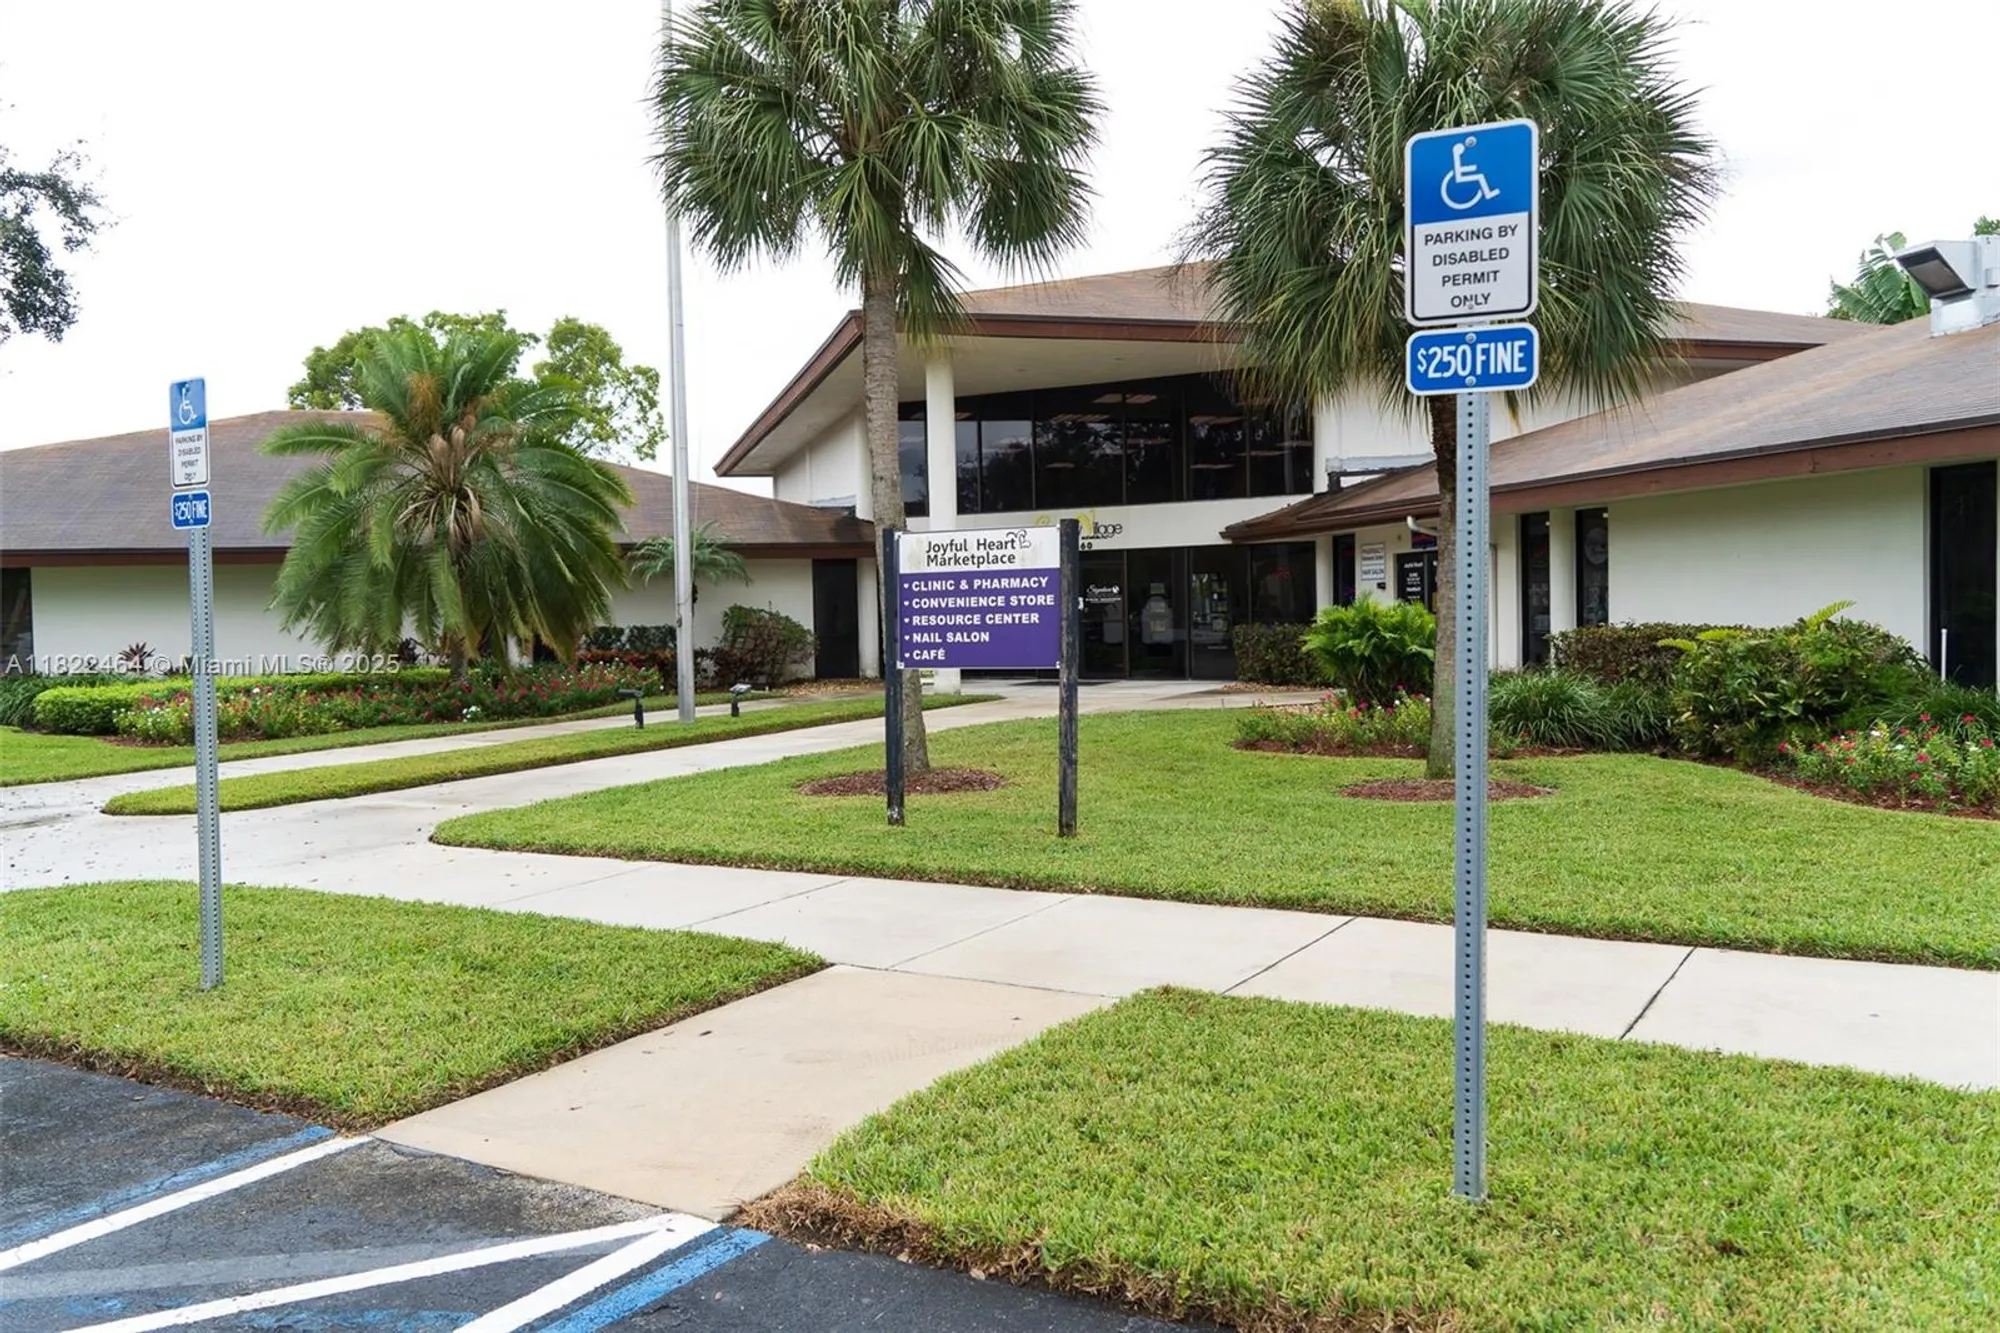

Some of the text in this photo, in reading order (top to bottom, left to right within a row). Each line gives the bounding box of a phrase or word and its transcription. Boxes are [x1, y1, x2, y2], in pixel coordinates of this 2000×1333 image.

[1424, 224, 1519, 246] PARKING BY
[1432, 247, 1510, 267] DISABLED
[1441, 270, 1500, 287] PERMIT
[1450, 292, 1491, 309] ONLY
[1417, 339, 1528, 379] $250 FINE
[175, 499, 208, 520] $250 FINE
[926, 537, 1016, 555] Joyful Heart
[926, 551, 1016, 569] Marketplace
[912, 576, 1049, 592] CLINIC & PHARMACY
[912, 594, 1055, 609] CONVENIENCE STORE
[912, 612, 1040, 626] RESOURCE CENTER
[913, 631, 990, 643] NAIL SALON
[913, 647, 946, 660] CAFÉ
